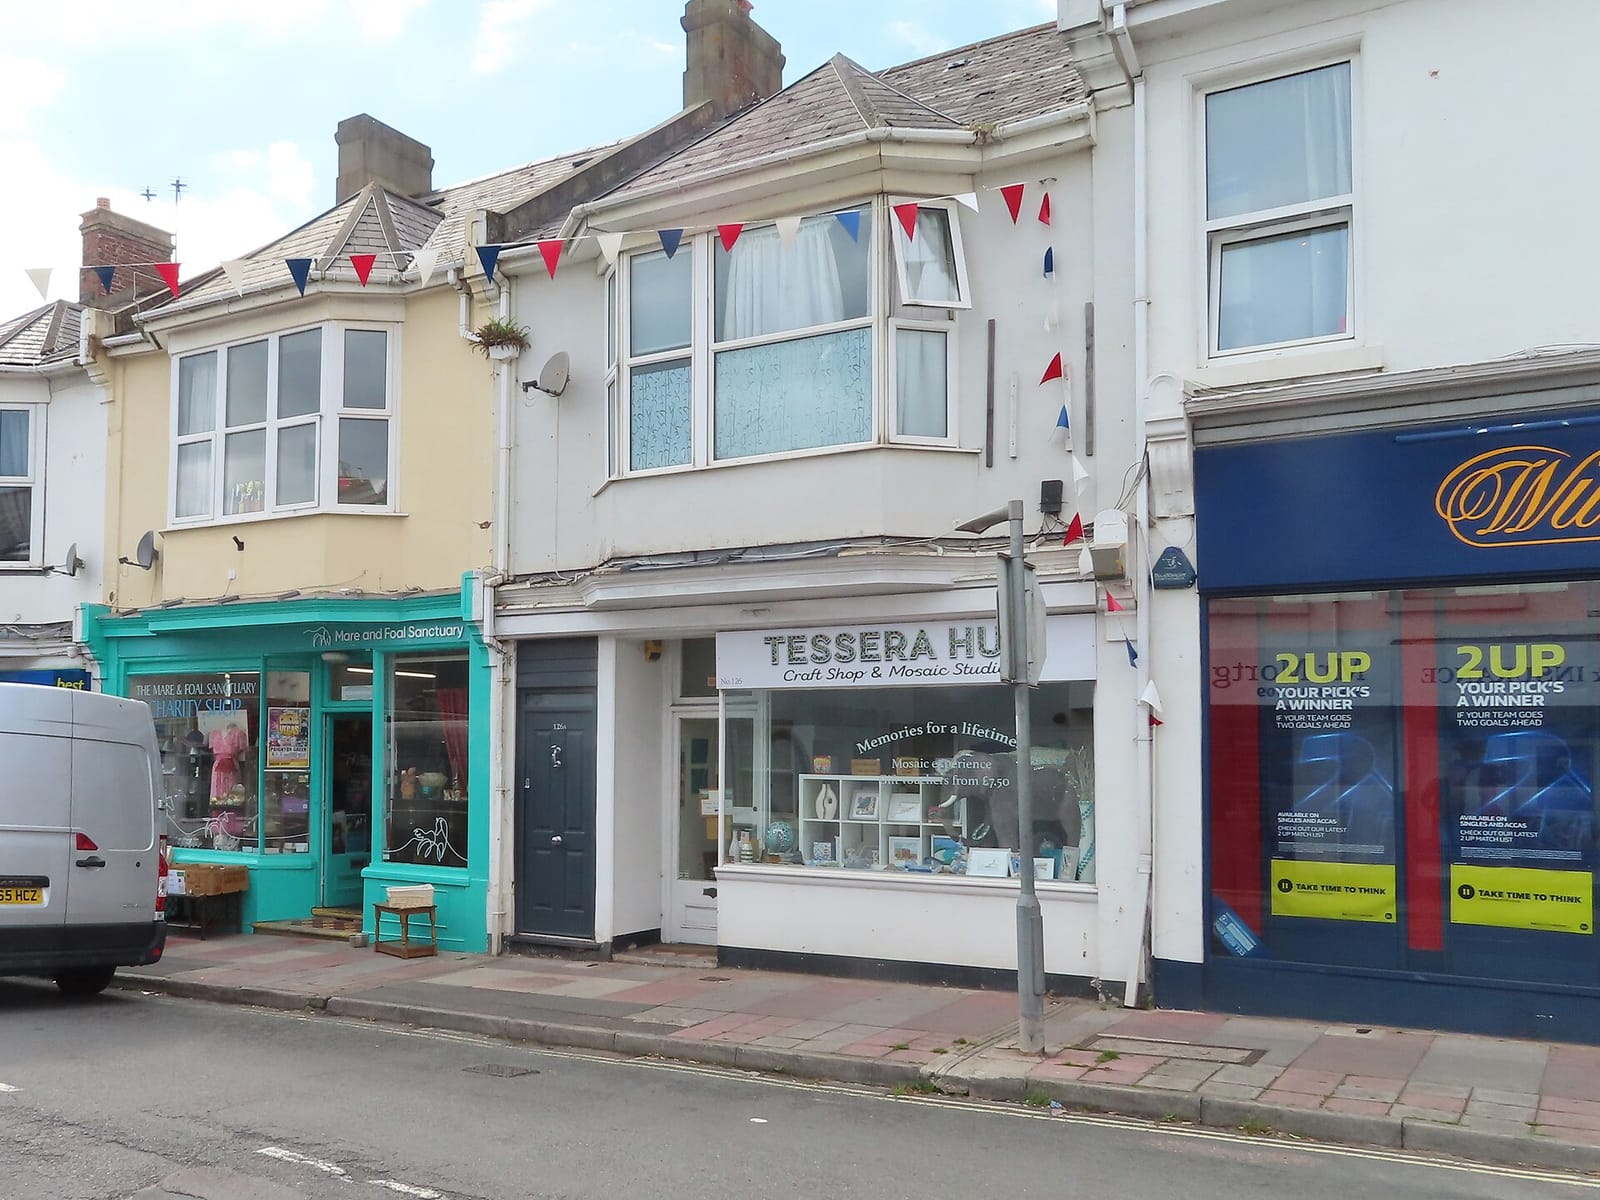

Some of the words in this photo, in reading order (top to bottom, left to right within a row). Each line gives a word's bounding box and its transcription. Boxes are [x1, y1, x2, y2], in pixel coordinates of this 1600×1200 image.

[335, 630, 360, 642] Mare
[363, 629, 382, 640] and
[384, 626, 406, 639] Foal
[408, 625, 464, 639] Sanctuary
[764, 629, 937, 665] TESSERA
[1275, 651, 1371, 684] 2UP
[1456, 643, 1566, 679] 2UP
[784, 667, 822, 682] Craft
[826, 667, 867, 683] Shop
[871, 666, 882, 678] &
[889, 665, 949, 678] Mosaic
[57, 677, 85, 691] best
[136, 684, 151, 696] THE
[153, 684, 175, 696] MARE
[176, 684, 182, 696] &
[184, 683, 205, 696] FOAL
[206, 682, 257, 695] SANCTUARY
[1456, 681, 1506, 694] YOUR
[1509, 681, 1564, 694] PICK'S
[1276, 686, 1319, 699] YOUR
[1322, 686, 1370, 698] PICK'S
[205, 698, 242, 717] SHOP
[1275, 699, 1289, 711] A
[1291, 699, 1352, 711] WINNER
[1456, 695, 1469, 707] A
[1472, 695, 1544, 707] WINNER
[1284, 714, 1305, 722] YOUR
[1307, 714, 1329, 722] TEAM
[1466, 711, 1489, 719] YOUR
[1492, 711, 1517, 719] TEAM
[1519, 711, 1543, 719] GOES
[1457, 719, 1478, 727] TWO
[1479, 719, 1509, 727] GOALS
[1510, 719, 1542, 727] AHEAD
[855, 726, 923, 754] Memories
[926, 721, 947, 734] for
[950, 724, 958, 734] a
[961, 721, 1017, 748] lifetime
[892, 758, 929, 769] Mosaic
[931, 758, 992, 771] eperience
[952, 774, 979, 786] from
[982, 776, 1010, 788] £7.50
[15, 889, 37, 901] HCZ
[1296, 883, 1318, 891] TAKE
[1344, 886, 1356, 894] TO
[1358, 887, 1386, 895] THINK
[1478, 889, 1503, 898] TAKE
[1507, 891, 1531, 900] TIME
[1533, 893, 1547, 901] TO
[1550, 895, 1582, 904] THINK
